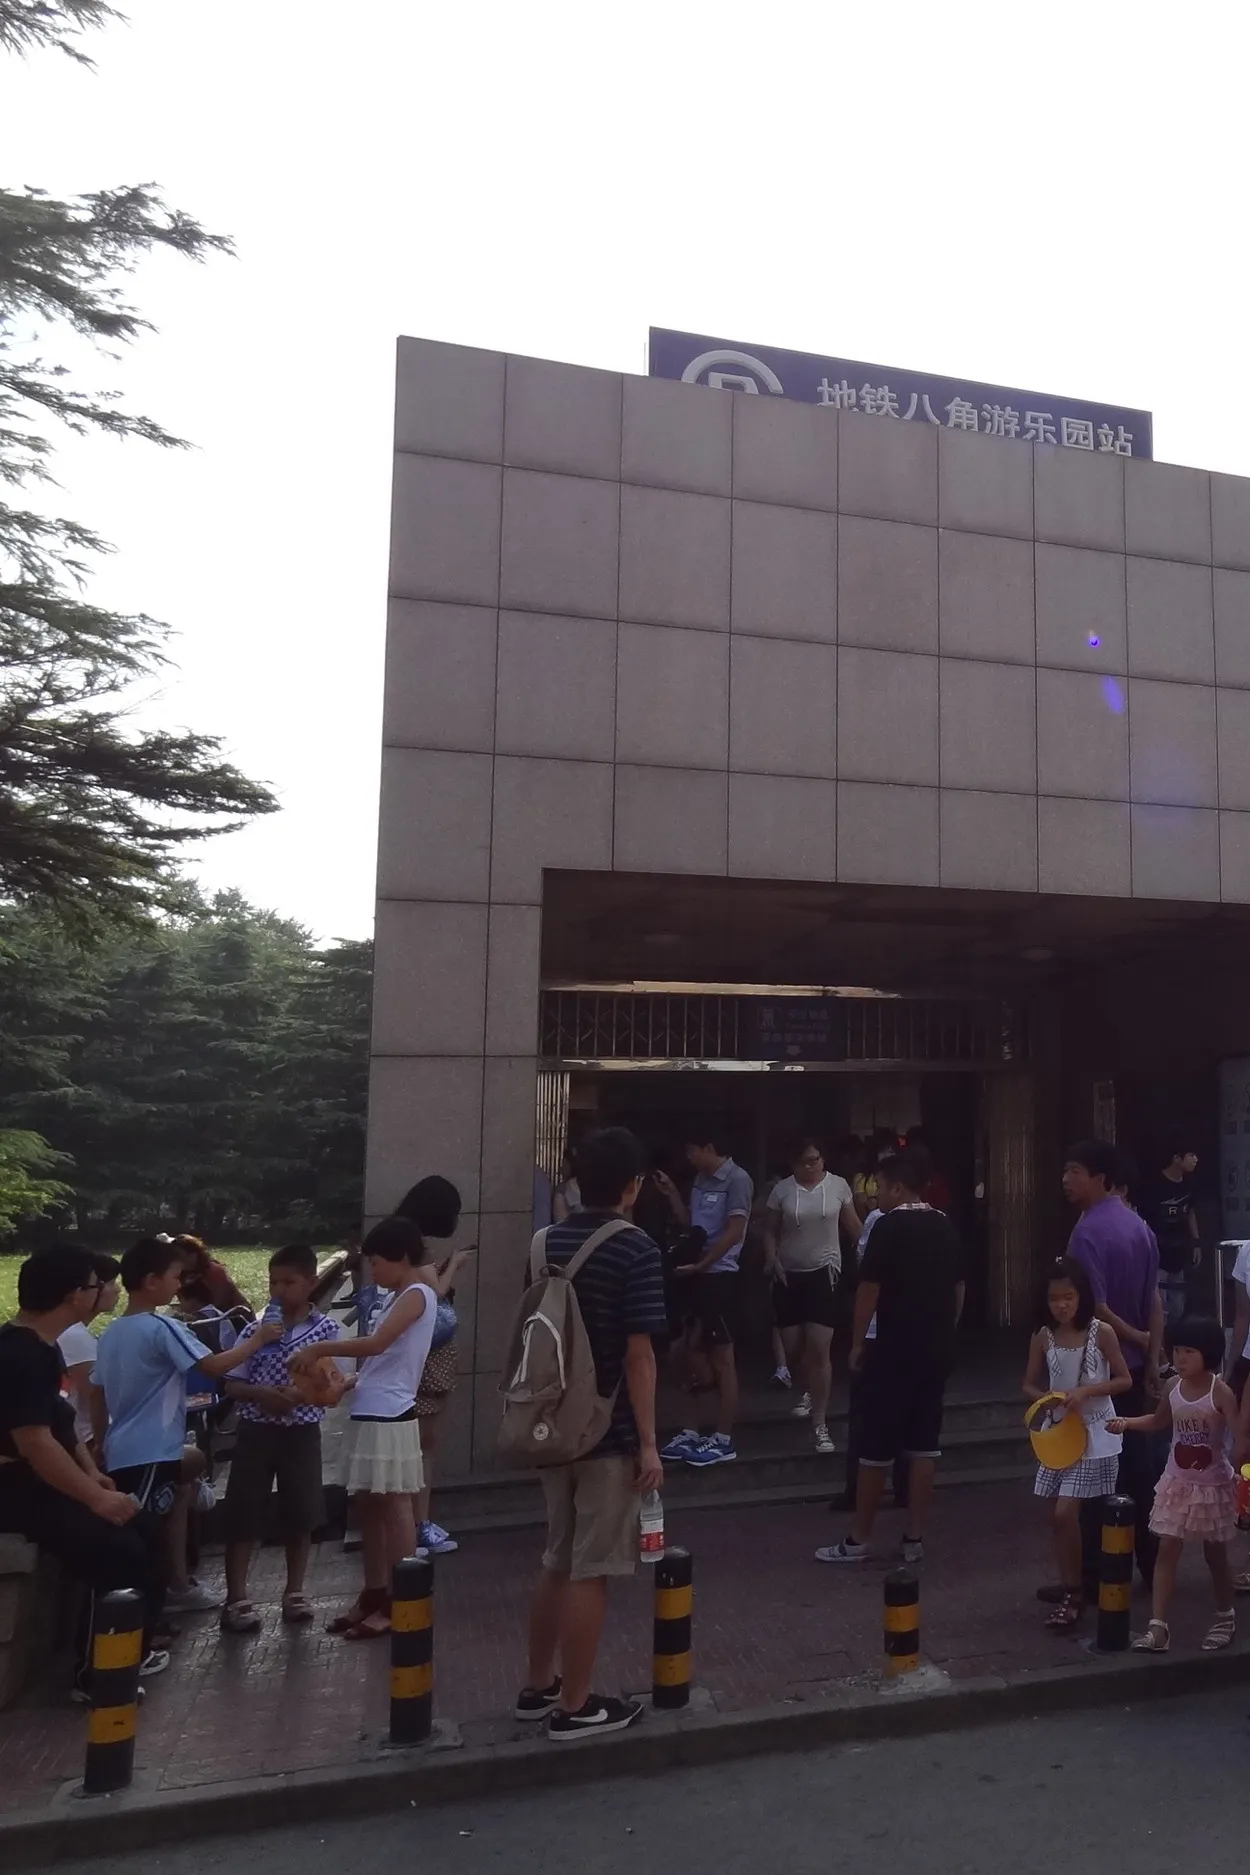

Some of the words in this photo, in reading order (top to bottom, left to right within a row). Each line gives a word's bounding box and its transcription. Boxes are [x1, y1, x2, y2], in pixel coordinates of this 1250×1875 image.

[816, 377, 1133, 457] 地铁八角游乐园站
[1176, 1418, 1198, 1433] LIKE
